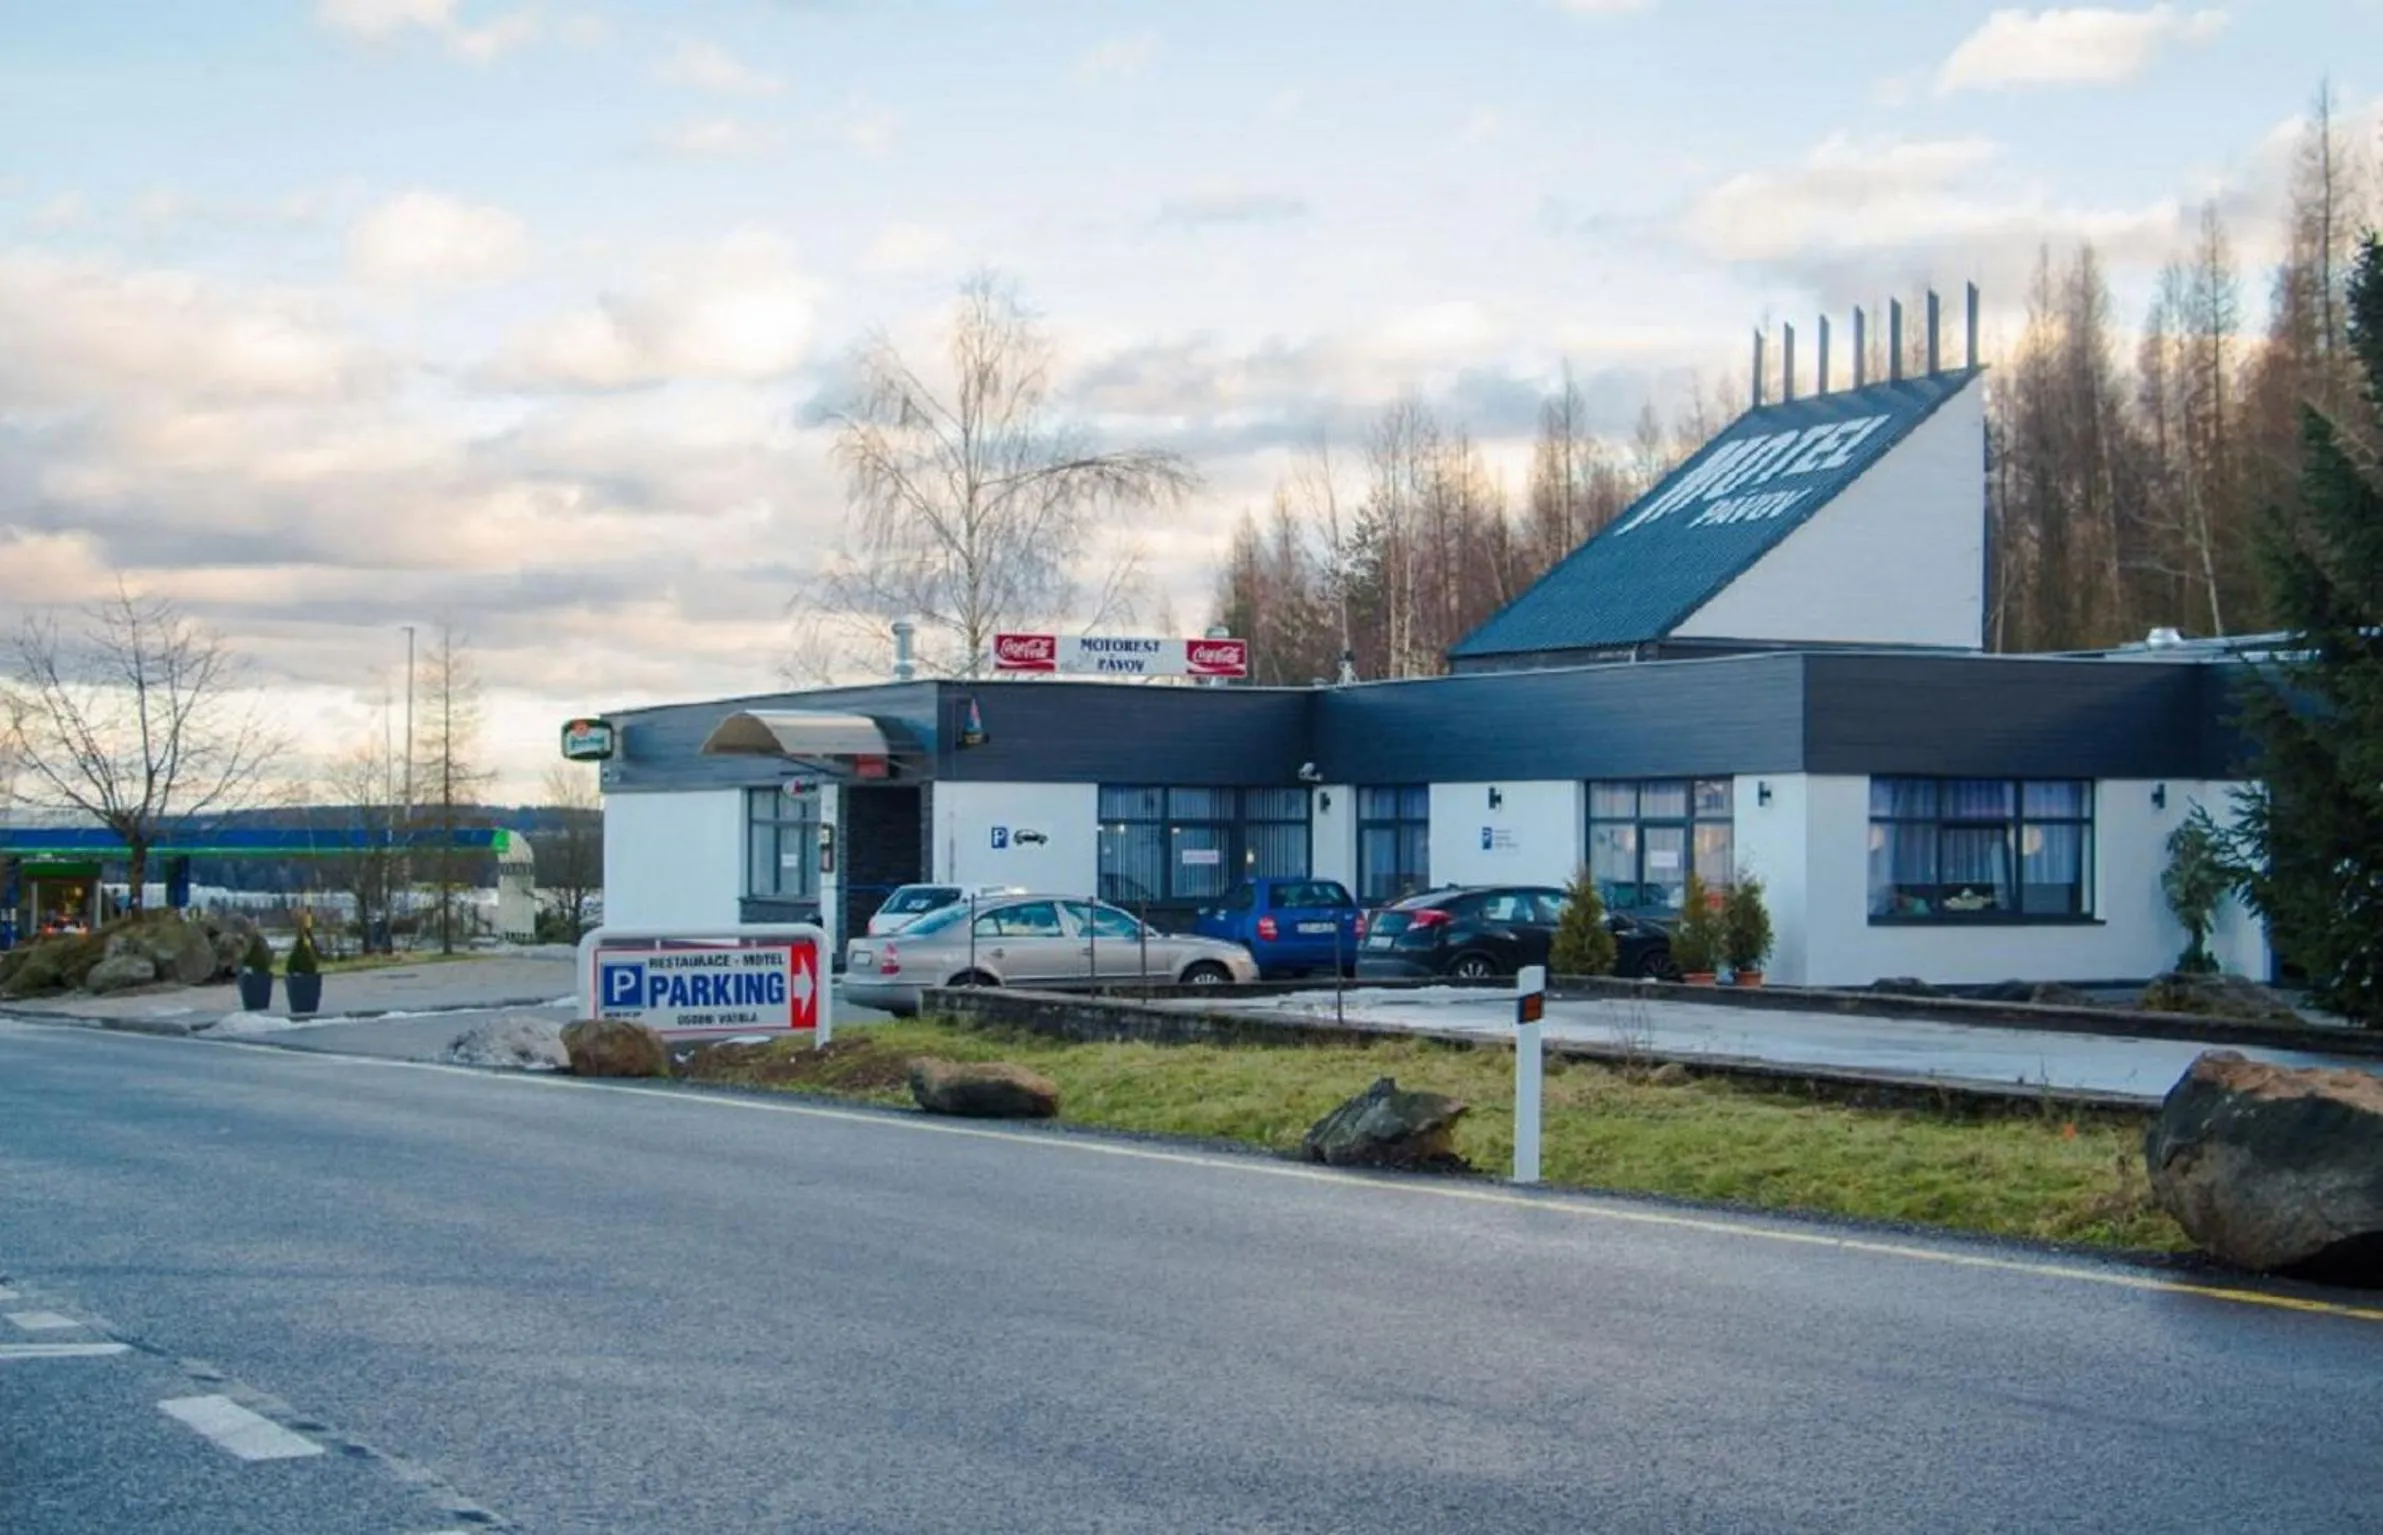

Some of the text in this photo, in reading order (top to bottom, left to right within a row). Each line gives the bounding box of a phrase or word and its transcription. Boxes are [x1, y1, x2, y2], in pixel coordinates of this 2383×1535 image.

[1613, 413, 1892, 536] MOTEL
[1080, 638, 1160, 652] MOTOREST
[649, 954, 730, 969] RESTAURACE
[743, 952, 784, 966] MOTEL
[612, 969, 635, 1002] P
[649, 971, 785, 1008] PARKING
